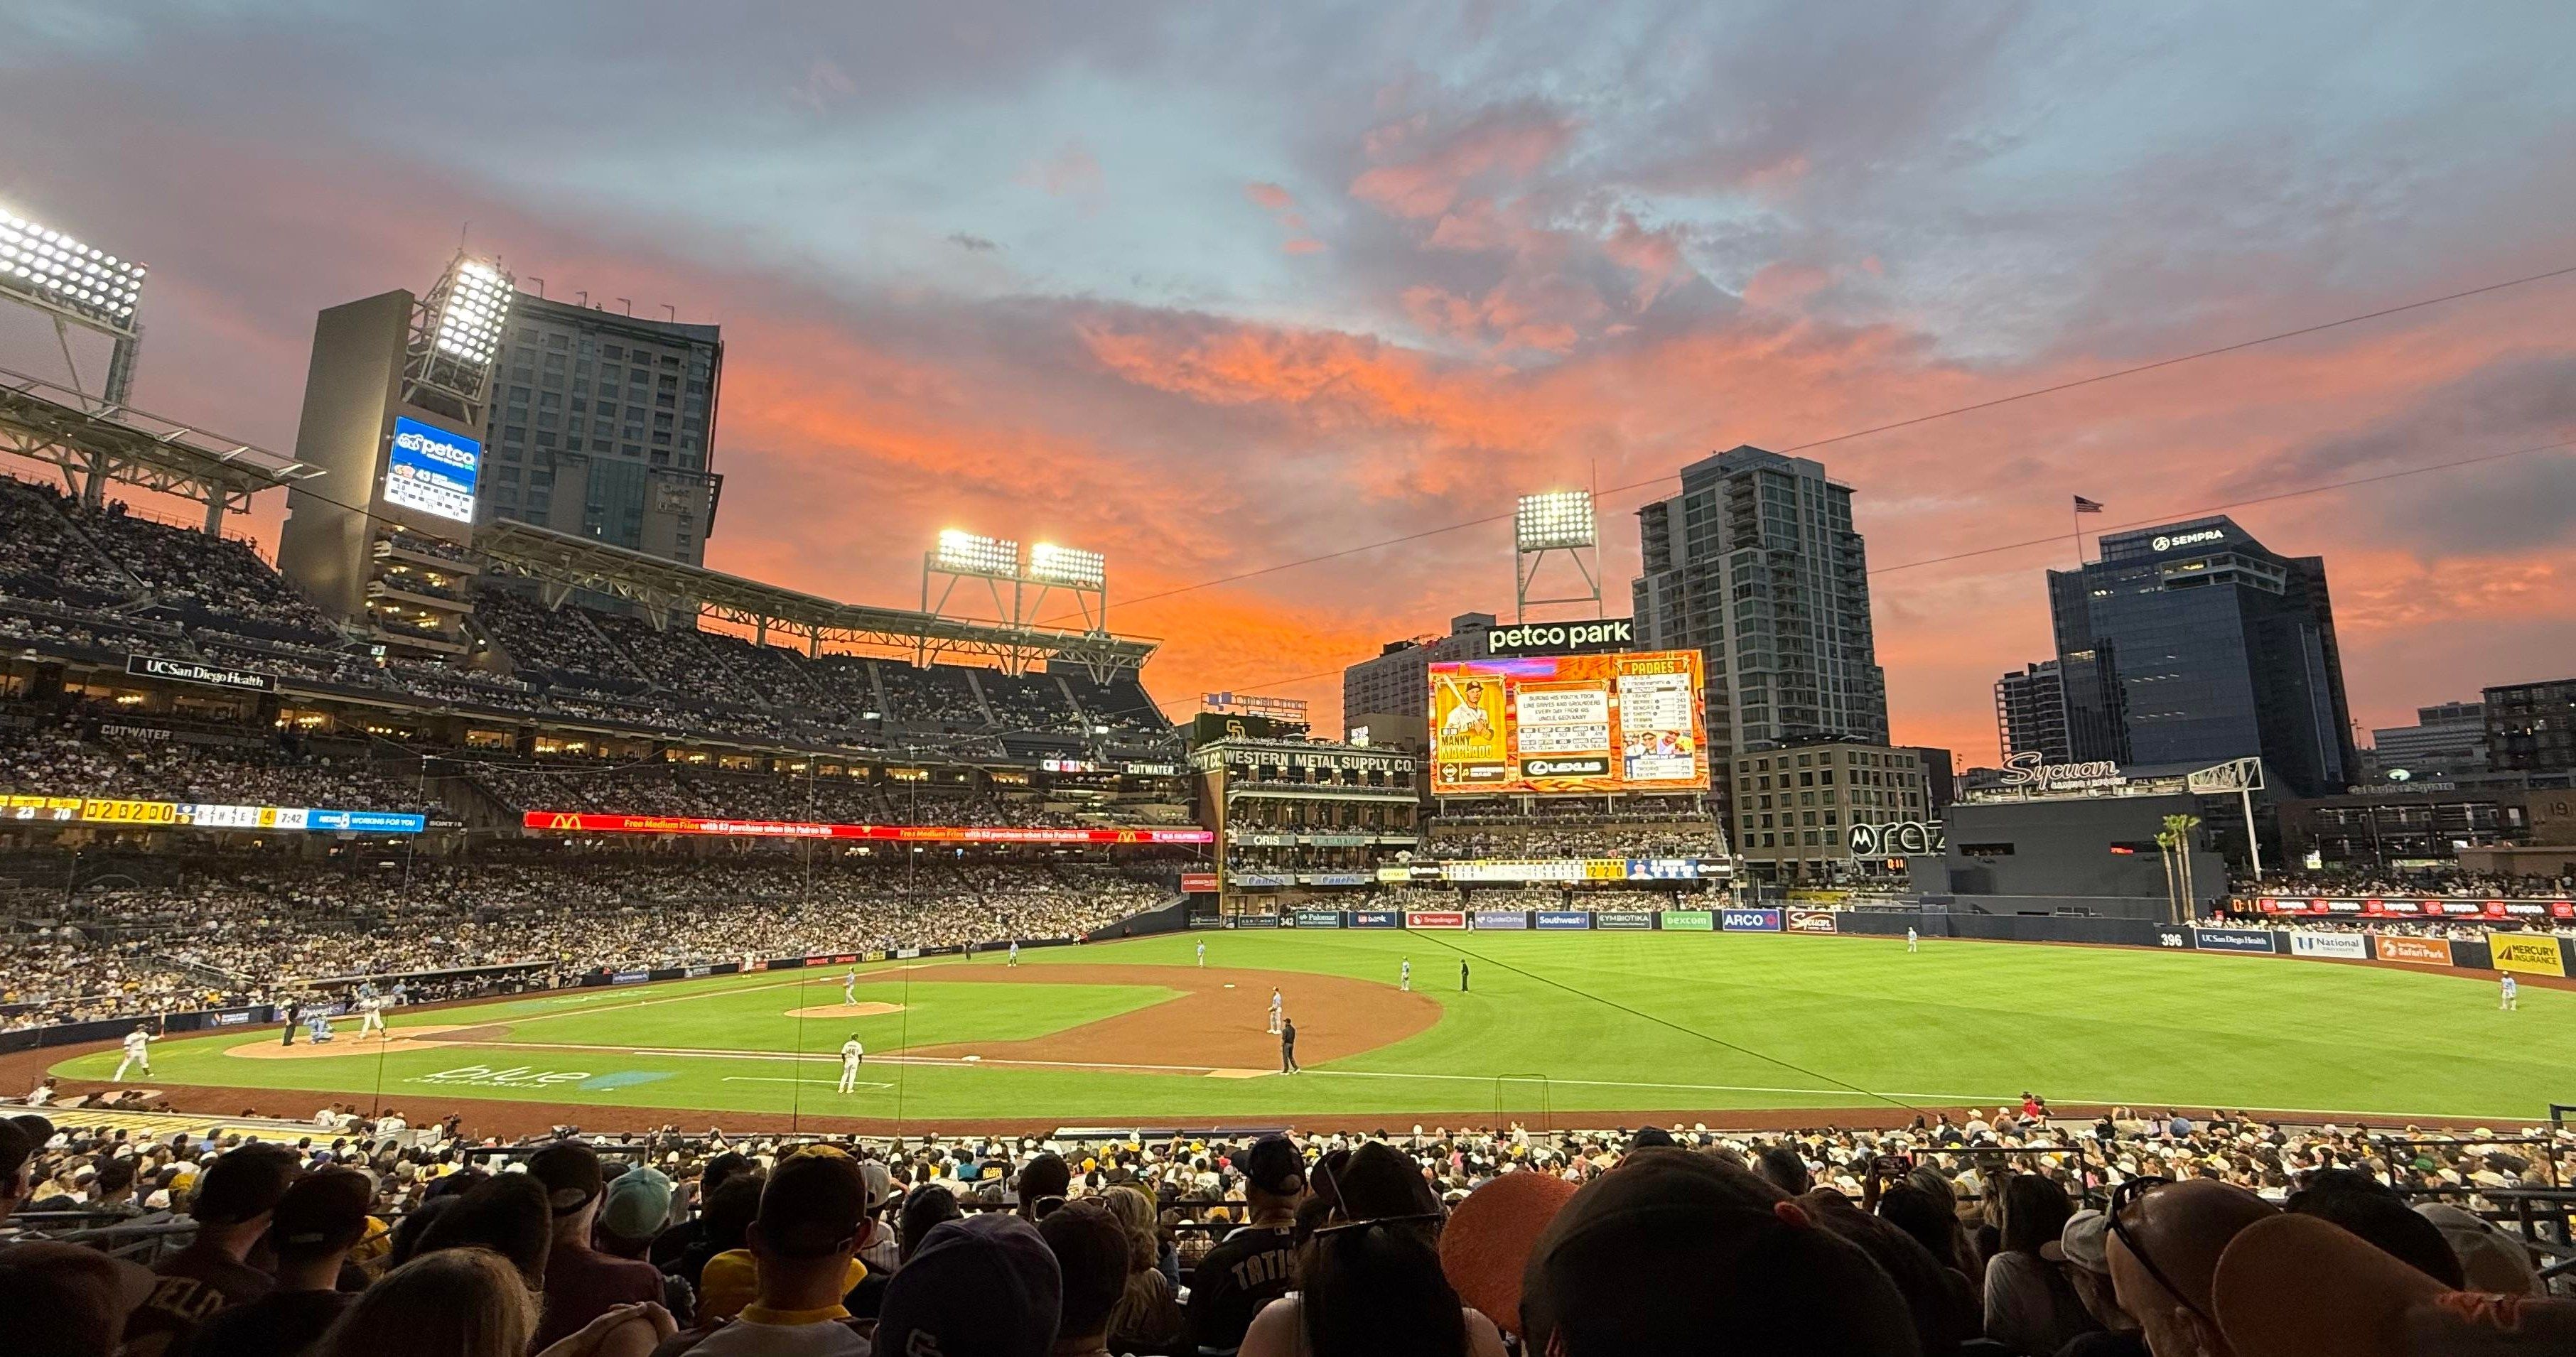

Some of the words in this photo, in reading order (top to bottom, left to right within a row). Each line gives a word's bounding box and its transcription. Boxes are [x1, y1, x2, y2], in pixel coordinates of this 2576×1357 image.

[422, 438, 475, 463] petco
[2172, 529, 2224, 546] SEMPRA
[1489, 627, 1565, 653] petco
[1570, 621, 1630, 649] park
[1632, 661, 1674, 674] PADRES
[193, 667, 226, 683] Diego
[227, 672, 264, 687] Health
[101, 724, 171, 740] CUTWATER
[1441, 735, 1470, 746] MANNY
[1441, 745, 1492, 759] MACHADO
[1224, 750, 1288, 766] WESTERN
[1295, 754, 1338, 768] METAL
[1342, 757, 1389, 771] SUPPLY
[1394, 759, 1416, 772] CO.
[1127, 764, 1173, 775] CUTWATER
[2000, 751, 2120, 790] Sycuan
[103, 802, 113, 819] 2
[133, 804, 143, 821] 2
[281, 813, 301, 824] 7:42
[624, 818, 643, 828] Free
[645, 819, 678, 829] Medium
[1254, 836, 1280, 846] ORIS
[1539, 915, 1580, 924] Southwest
[1725, 914, 1764, 926] ARCO
[2161, 934, 2183, 946] 396
[2225, 936, 2245, 946] Diego
[2246, 936, 2267, 946] Health
[2317, 937, 2359, 948] National
[2398, 947, 2423, 957] Safari
[2423, 948, 2445, 958] Park
[2513, 944, 2555, 956] MERCURY
[2513, 954, 2558, 966] INSURANCE
[426, 1064, 591, 1083] blue
